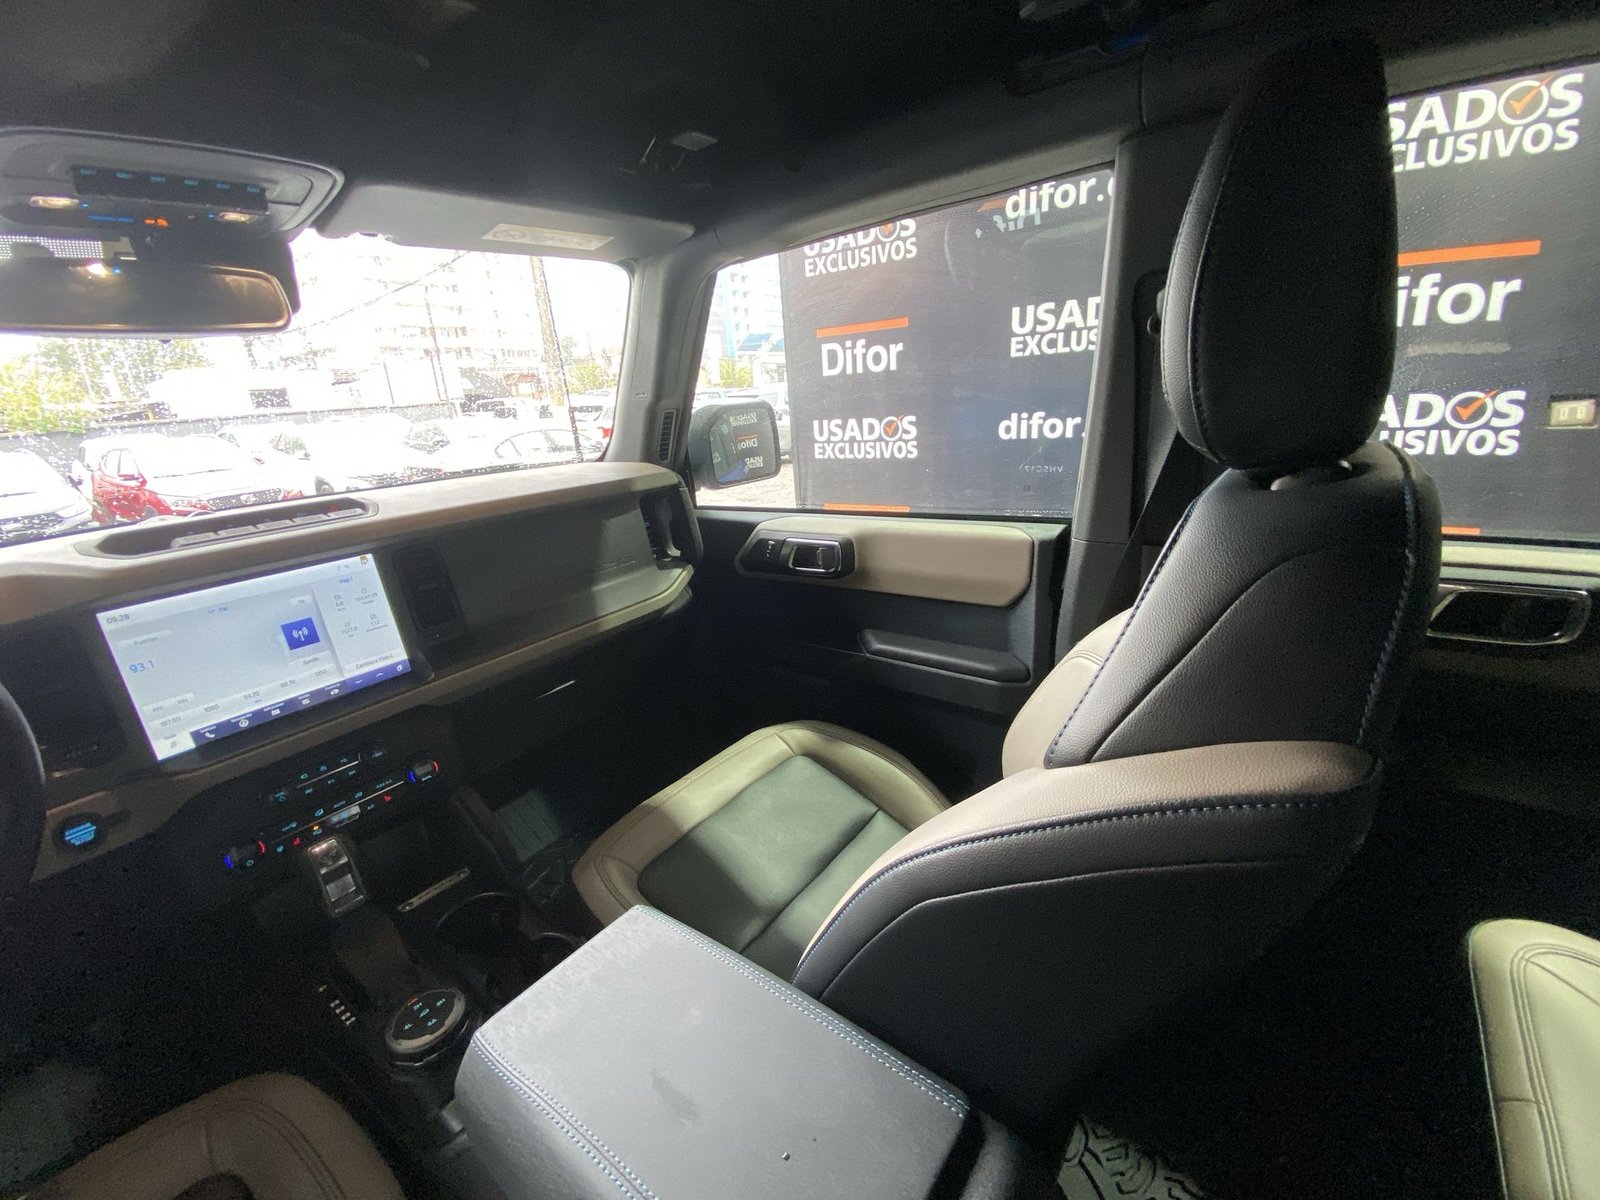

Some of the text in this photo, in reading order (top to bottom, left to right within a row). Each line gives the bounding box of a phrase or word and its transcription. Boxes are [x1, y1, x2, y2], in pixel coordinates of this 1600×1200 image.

[803, 218, 917, 257] USADOS
[804, 237, 918, 277] EXCLUSIVOS
[821, 338, 904, 377] Difor
[812, 415, 918, 442] USADOS
[813, 440, 918, 459] EXCLUSIVOS
[129, 659, 155, 674] 93.1
